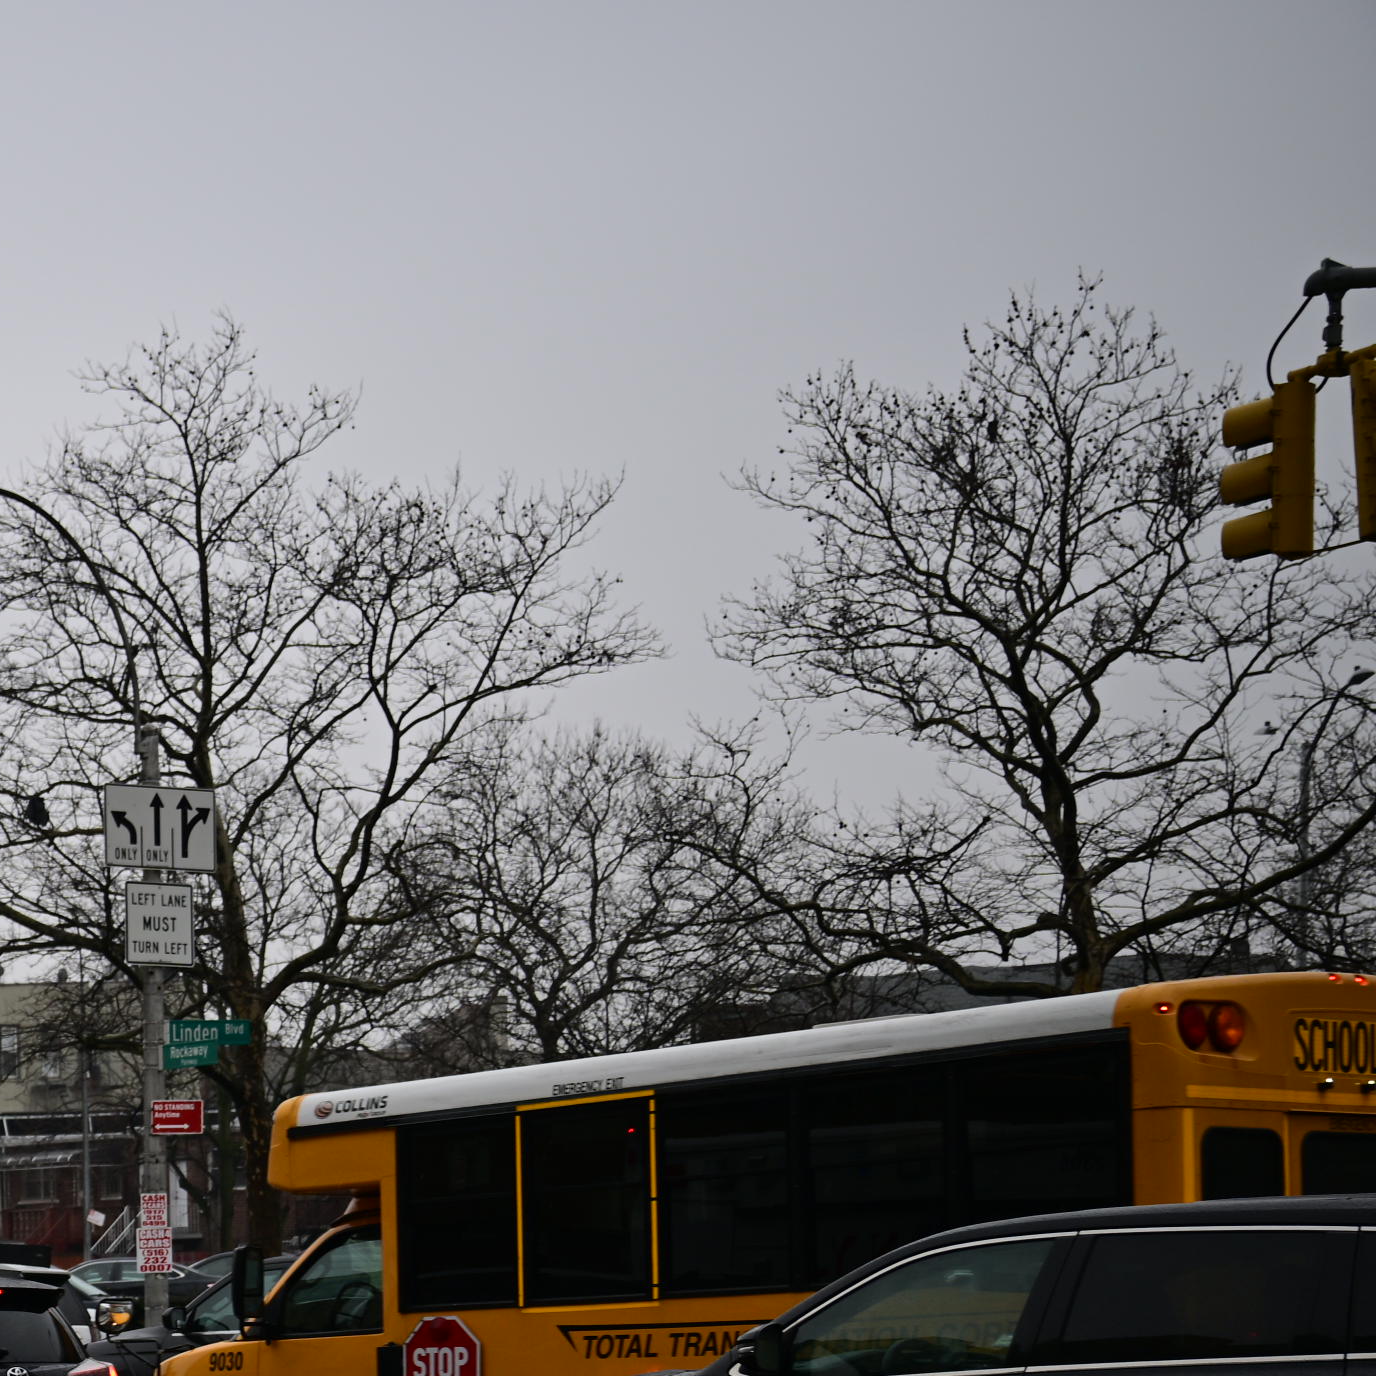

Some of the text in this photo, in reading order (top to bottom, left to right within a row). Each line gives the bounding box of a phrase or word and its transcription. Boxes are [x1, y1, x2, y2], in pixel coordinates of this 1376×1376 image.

[114, 848, 137, 861] ONLY
[146, 850, 168, 862] ONLY
[131, 892, 187, 908] LEFT LANE
[143, 916, 176, 932] MUST
[132, 940, 188, 955] TURN LEFT
[172, 1022, 244, 1042] Linden Blvd
[170, 1046, 208, 1060] Rockaway
[552, 1076, 624, 1096] EMERGENCY EXIT
[335, 1096, 388, 1114] COLLINS
[140, 1240, 170, 1248] CARS
[142, 1248, 168, 1256] (516)
[144, 1256, 168, 1264] 232
[140, 1264, 171, 1272] 0007
[583, 1334, 658, 1360] TOTAL
[209, 1352, 244, 1372] 9030
